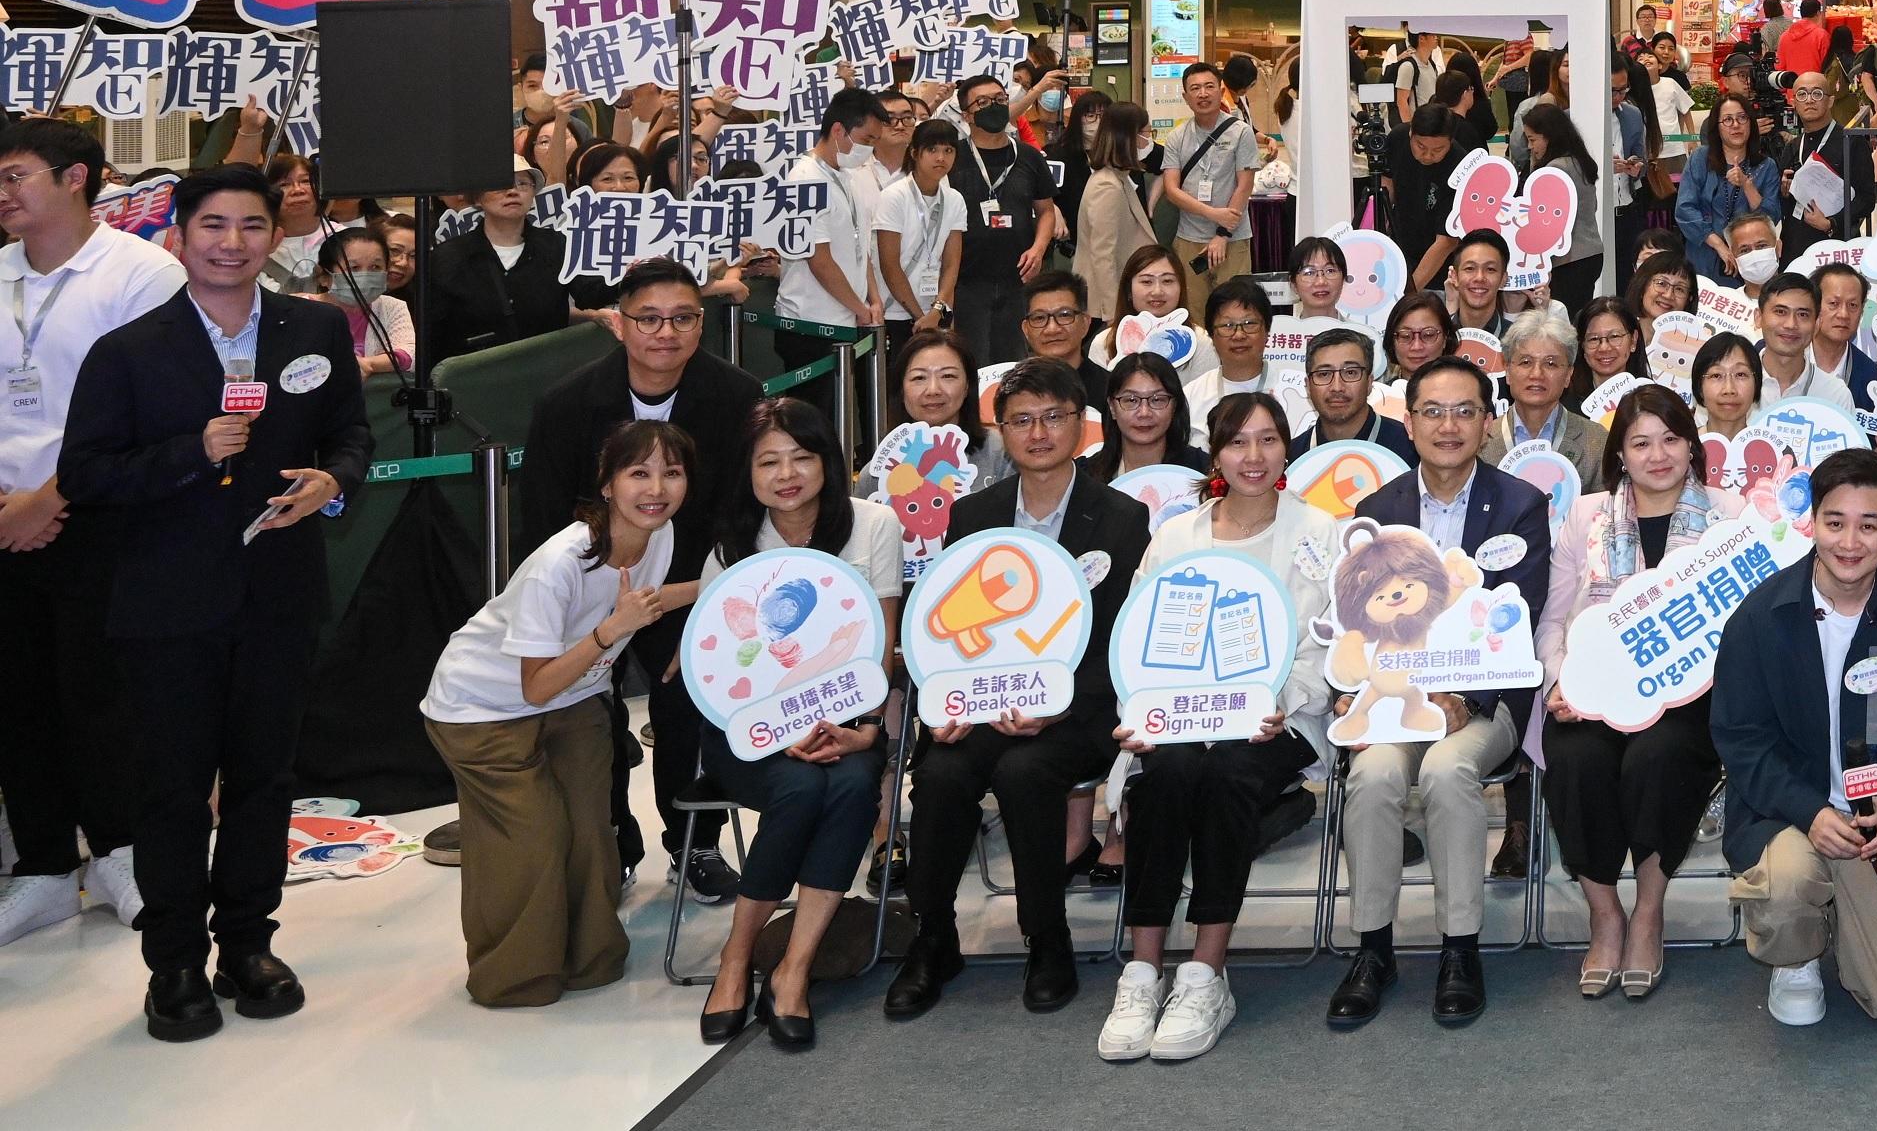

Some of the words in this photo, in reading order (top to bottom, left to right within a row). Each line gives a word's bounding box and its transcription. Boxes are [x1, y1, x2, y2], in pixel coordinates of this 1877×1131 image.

[818, 324, 835, 337] MCP
[1716, 317, 1740, 333] Now!
[795, 366, 813, 383] MCP
[13, 396, 38, 408] CREW
[229, 385, 263, 397] RTHK
[1607, 583, 1663, 630] 全民響應
[1676, 555, 1708, 583] Let's
[1703, 524, 1755, 562] Support
[1620, 540, 1781, 669] 器官捐贈
[1377, 648, 1481, 670] 支持器官捐贈
[971, 669, 1046, 692] 告訴家人
[1408, 671, 1453, 686] Support
[1453, 670, 1487, 685] Organ
[1487, 668, 1535, 681] Donation
[1636, 646, 1706, 698] Organ
[780, 670, 860, 719] 傳播希望
[944, 689, 1047, 717] Speak-out
[1172, 692, 1247, 715] 登記意願
[749, 688, 865, 749] Spread-out
[1144, 707, 1225, 736] Sign-up
[1847, 768, 1877, 783] RTHK
